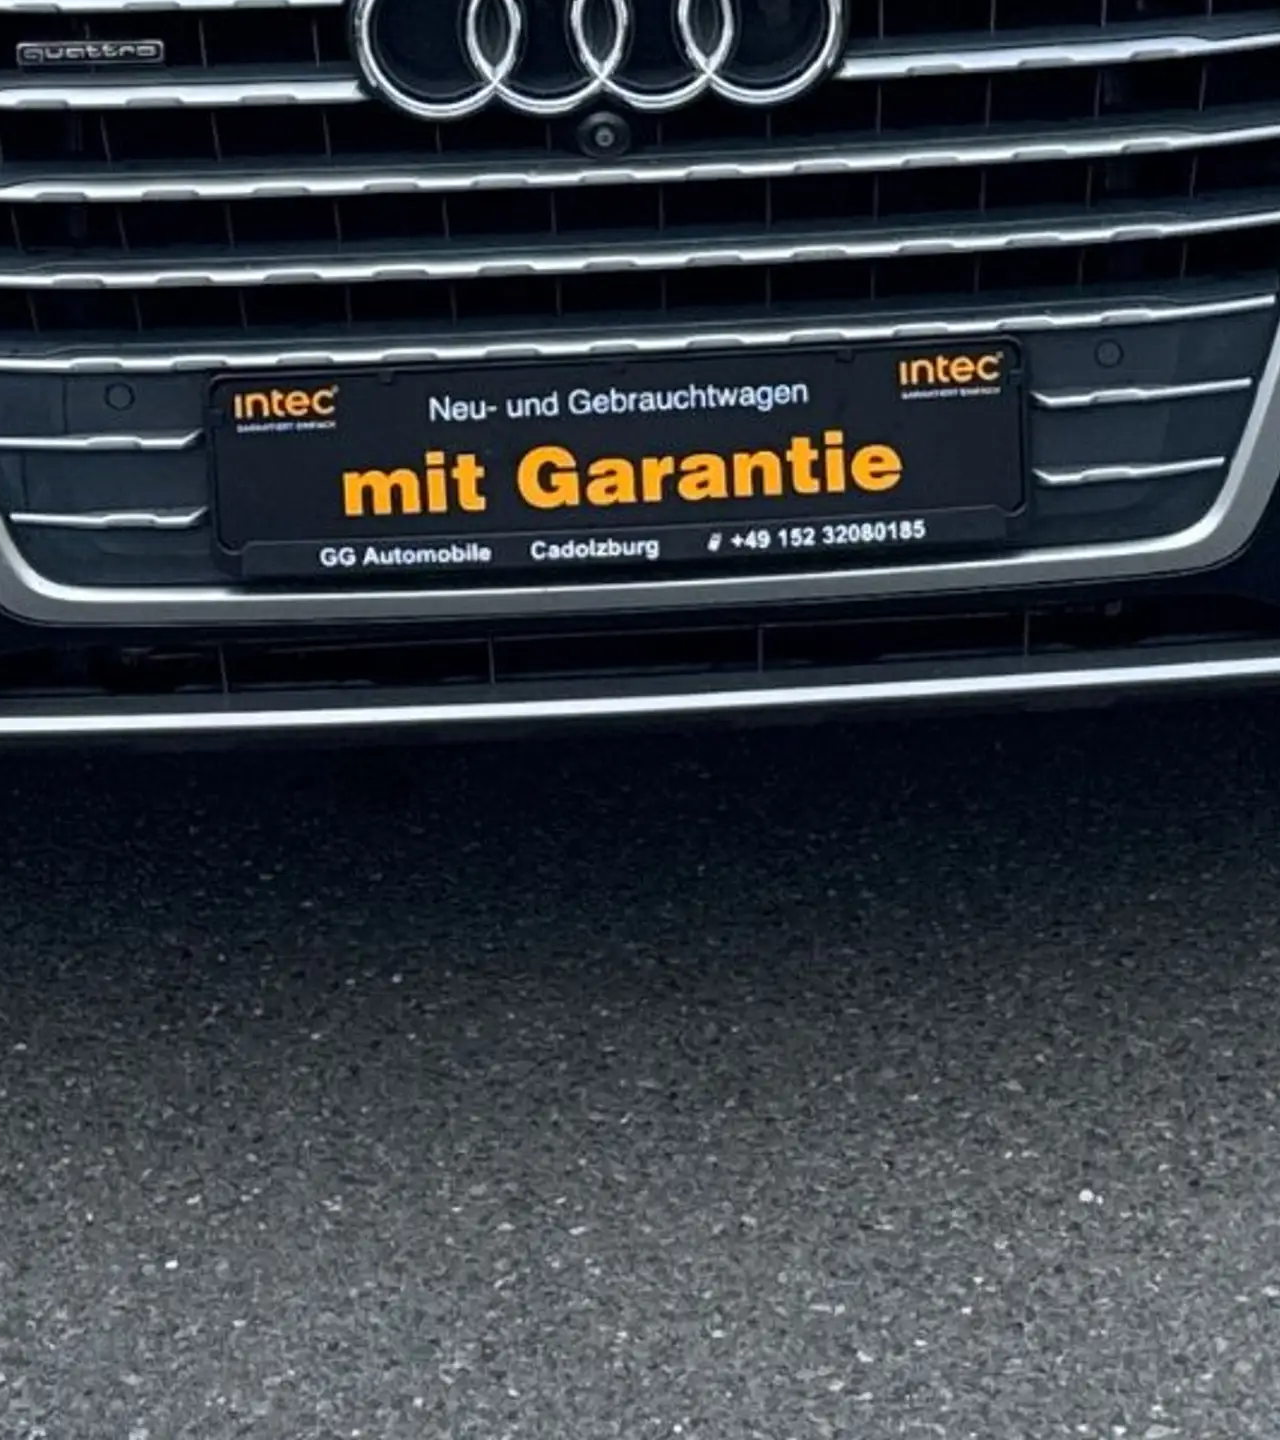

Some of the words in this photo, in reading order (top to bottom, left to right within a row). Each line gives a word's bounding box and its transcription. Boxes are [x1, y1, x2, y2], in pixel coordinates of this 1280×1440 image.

[22, 44, 157, 63] quattro
[899, 354, 1001, 386] intec
[233, 388, 336, 419] intec
[429, 396, 497, 422] Neu-
[506, 391, 559, 418] und
[568, 382, 809, 415] Gebrauchtwagen
[342, 451, 487, 517] mit
[517, 430, 903, 510] Garantie
[320, 546, 356, 568] GG
[363, 542, 492, 567] Automobile
[531, 538, 660, 560] Cadolzburg
[730, 529, 771, 549] +49
[778, 527, 816, 548] 152
[822, 519, 926, 545] 32080185
